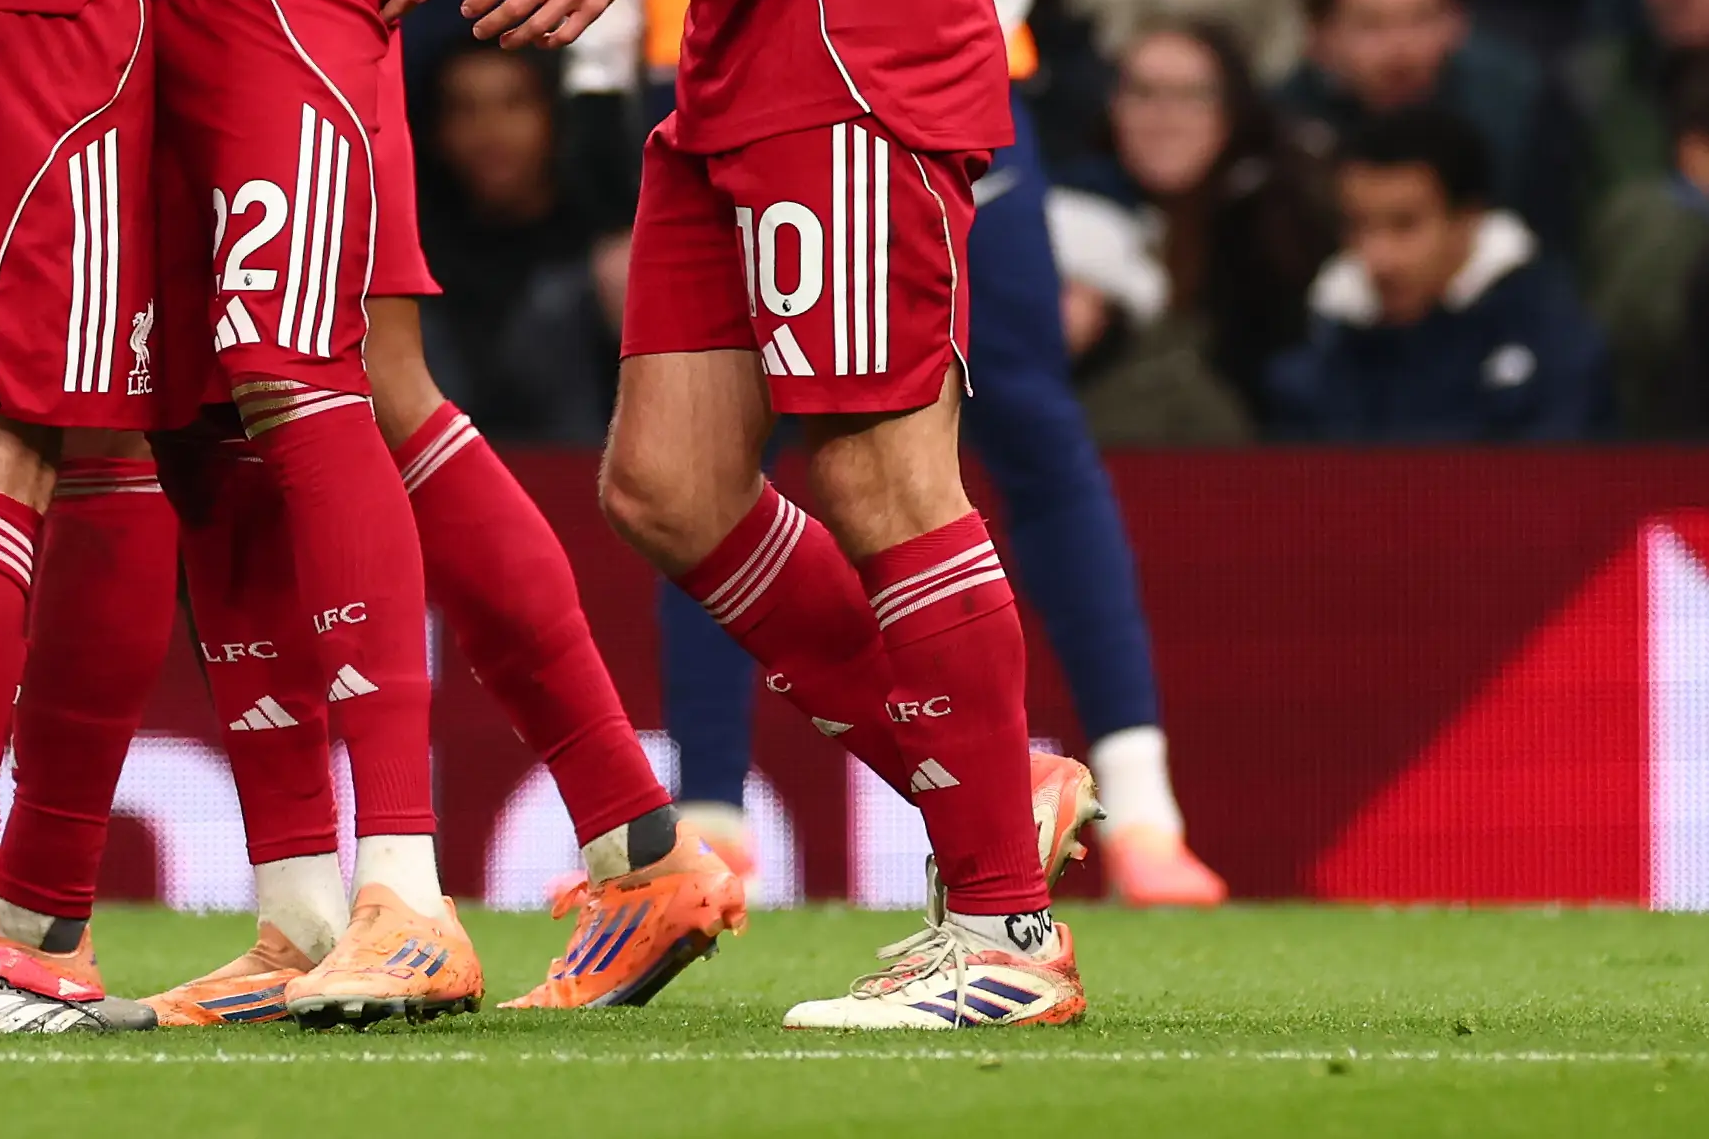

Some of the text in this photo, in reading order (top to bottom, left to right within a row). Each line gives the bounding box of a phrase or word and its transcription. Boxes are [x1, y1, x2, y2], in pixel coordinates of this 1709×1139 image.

[735, 201, 824, 318] 10
[313, 602, 367, 634] LFC
[200, 640, 279, 662] LFC
